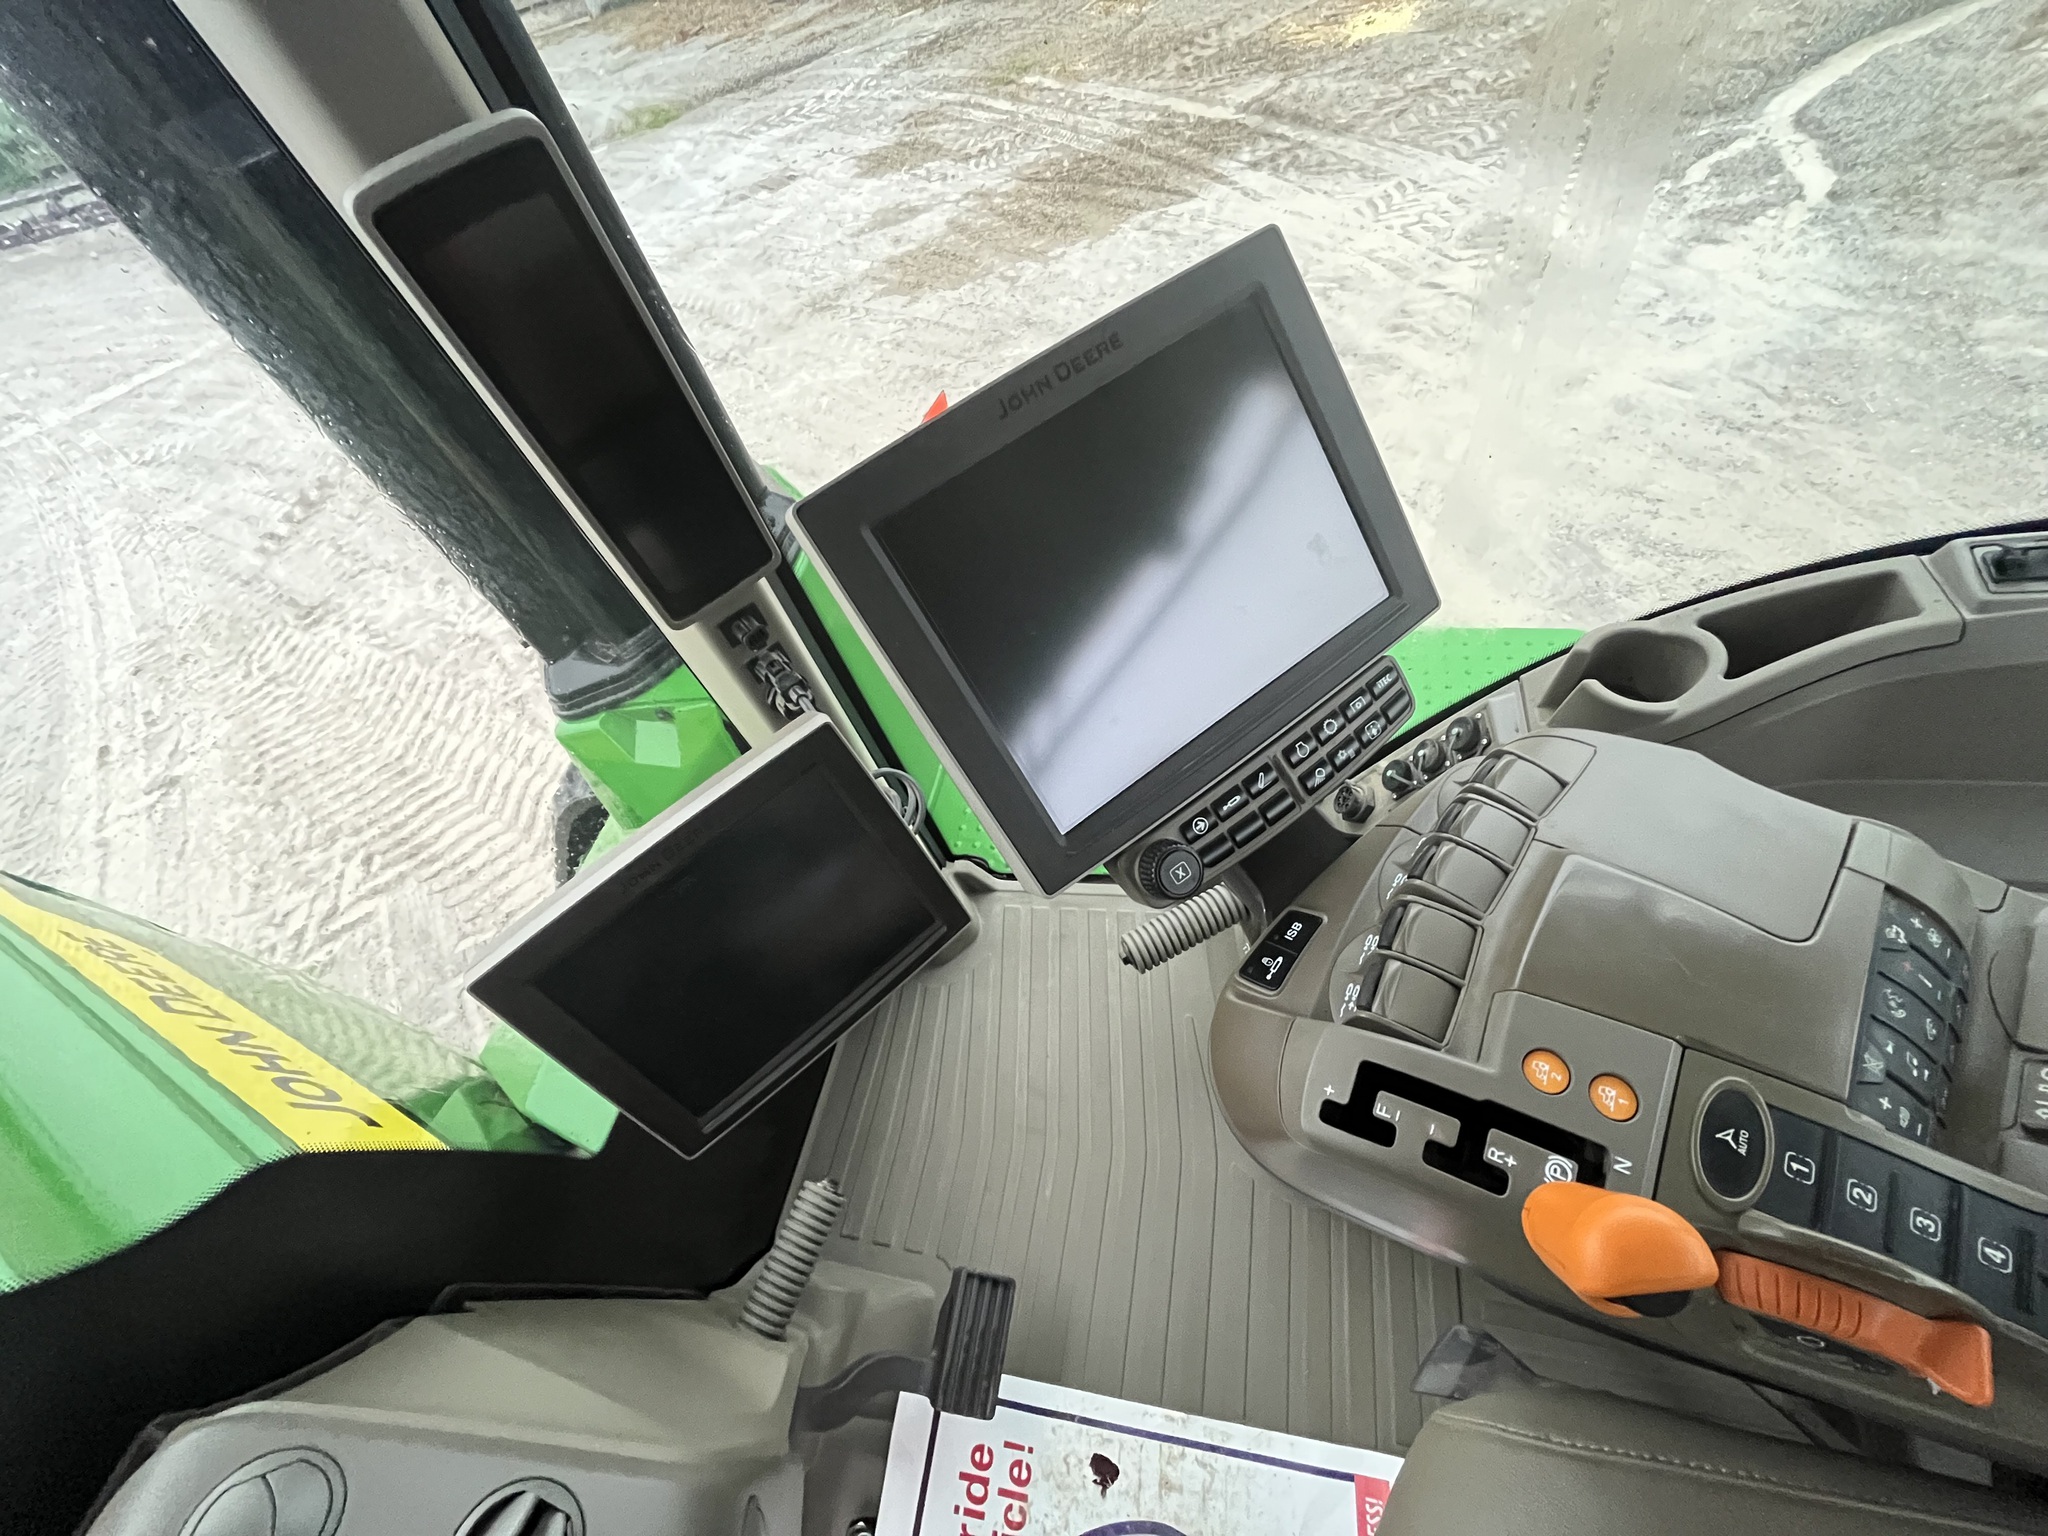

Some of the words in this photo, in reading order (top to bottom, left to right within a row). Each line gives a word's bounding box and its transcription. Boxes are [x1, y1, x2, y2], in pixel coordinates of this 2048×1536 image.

[997, 373, 1053, 421] JOHN
[1053, 330, 1124, 383] DEERE
[1375, 673, 1393, 689] iTEC
[1284, 921, 1303, 941] ISB
[57, 929, 236, 1023] DEERE
[195, 1024, 384, 1129] JOHN
[1550, 1071, 1563, 1082] 2
[1375, 1102, 1392, 1119] F
[1617, 1097, 1630, 1107] 1
[1737, 1129, 1749, 1156] AUTO
[1487, 1147, 1507, 1164] R
[1612, 1155, 1633, 1175] N
[1789, 1158, 1811, 1176] 1
[1851, 1186, 1874, 1206] 2
[1914, 1215, 1937, 1233] 3
[1982, 1245, 2007, 1265] 4
